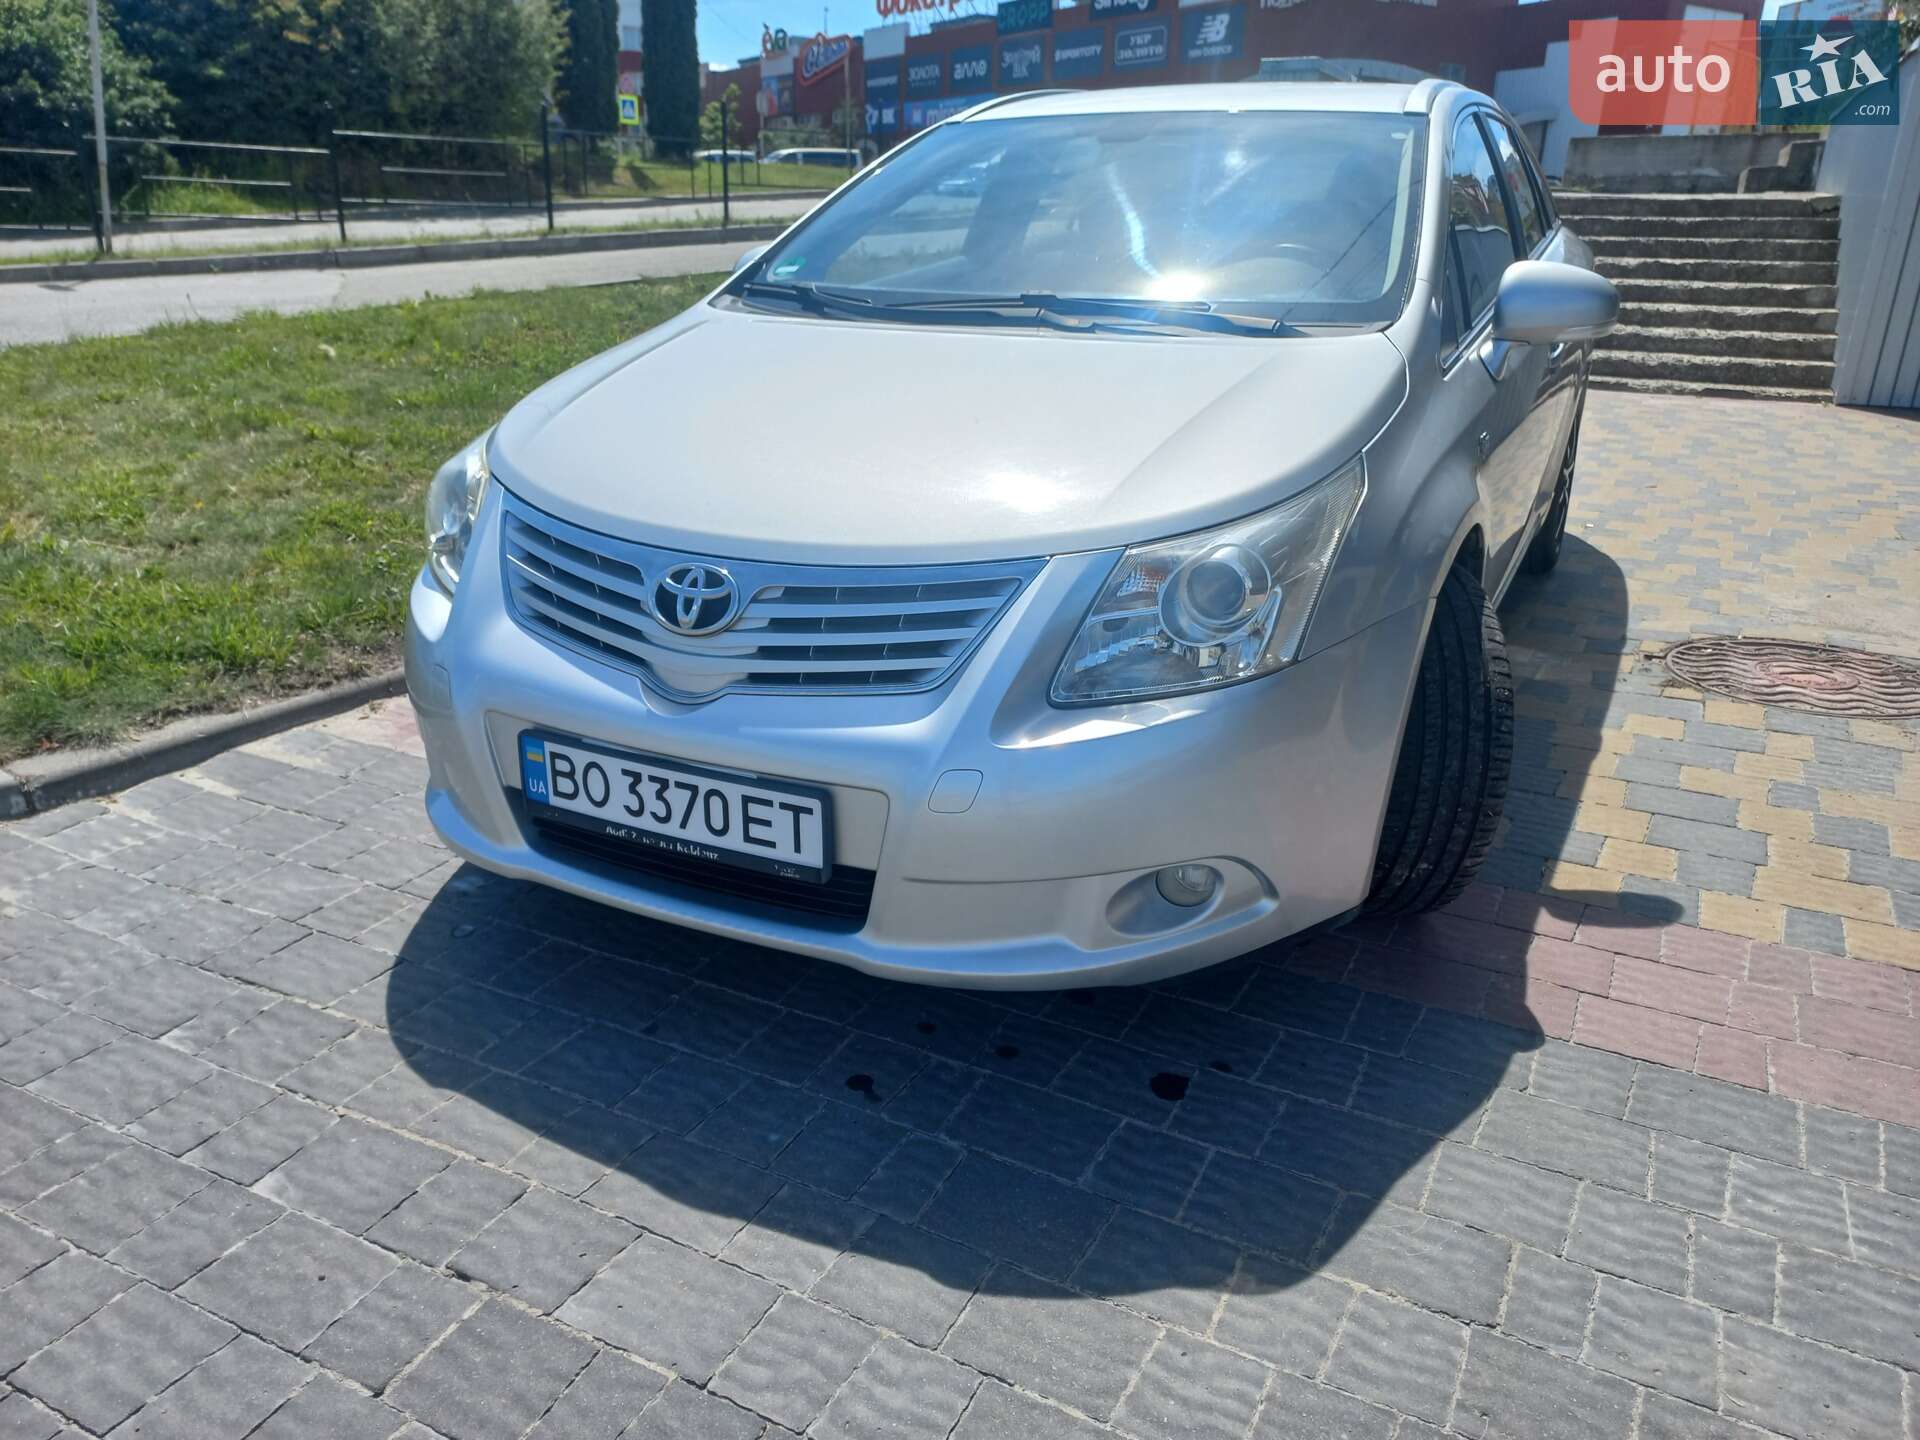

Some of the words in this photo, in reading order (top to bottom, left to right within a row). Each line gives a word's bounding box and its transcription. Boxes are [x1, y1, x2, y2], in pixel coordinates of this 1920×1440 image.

[529, 778, 547, 796] UA
[550, 752, 611, 808] BO
[621, 768, 730, 838] 3370
[741, 794, 814, 854] ET
